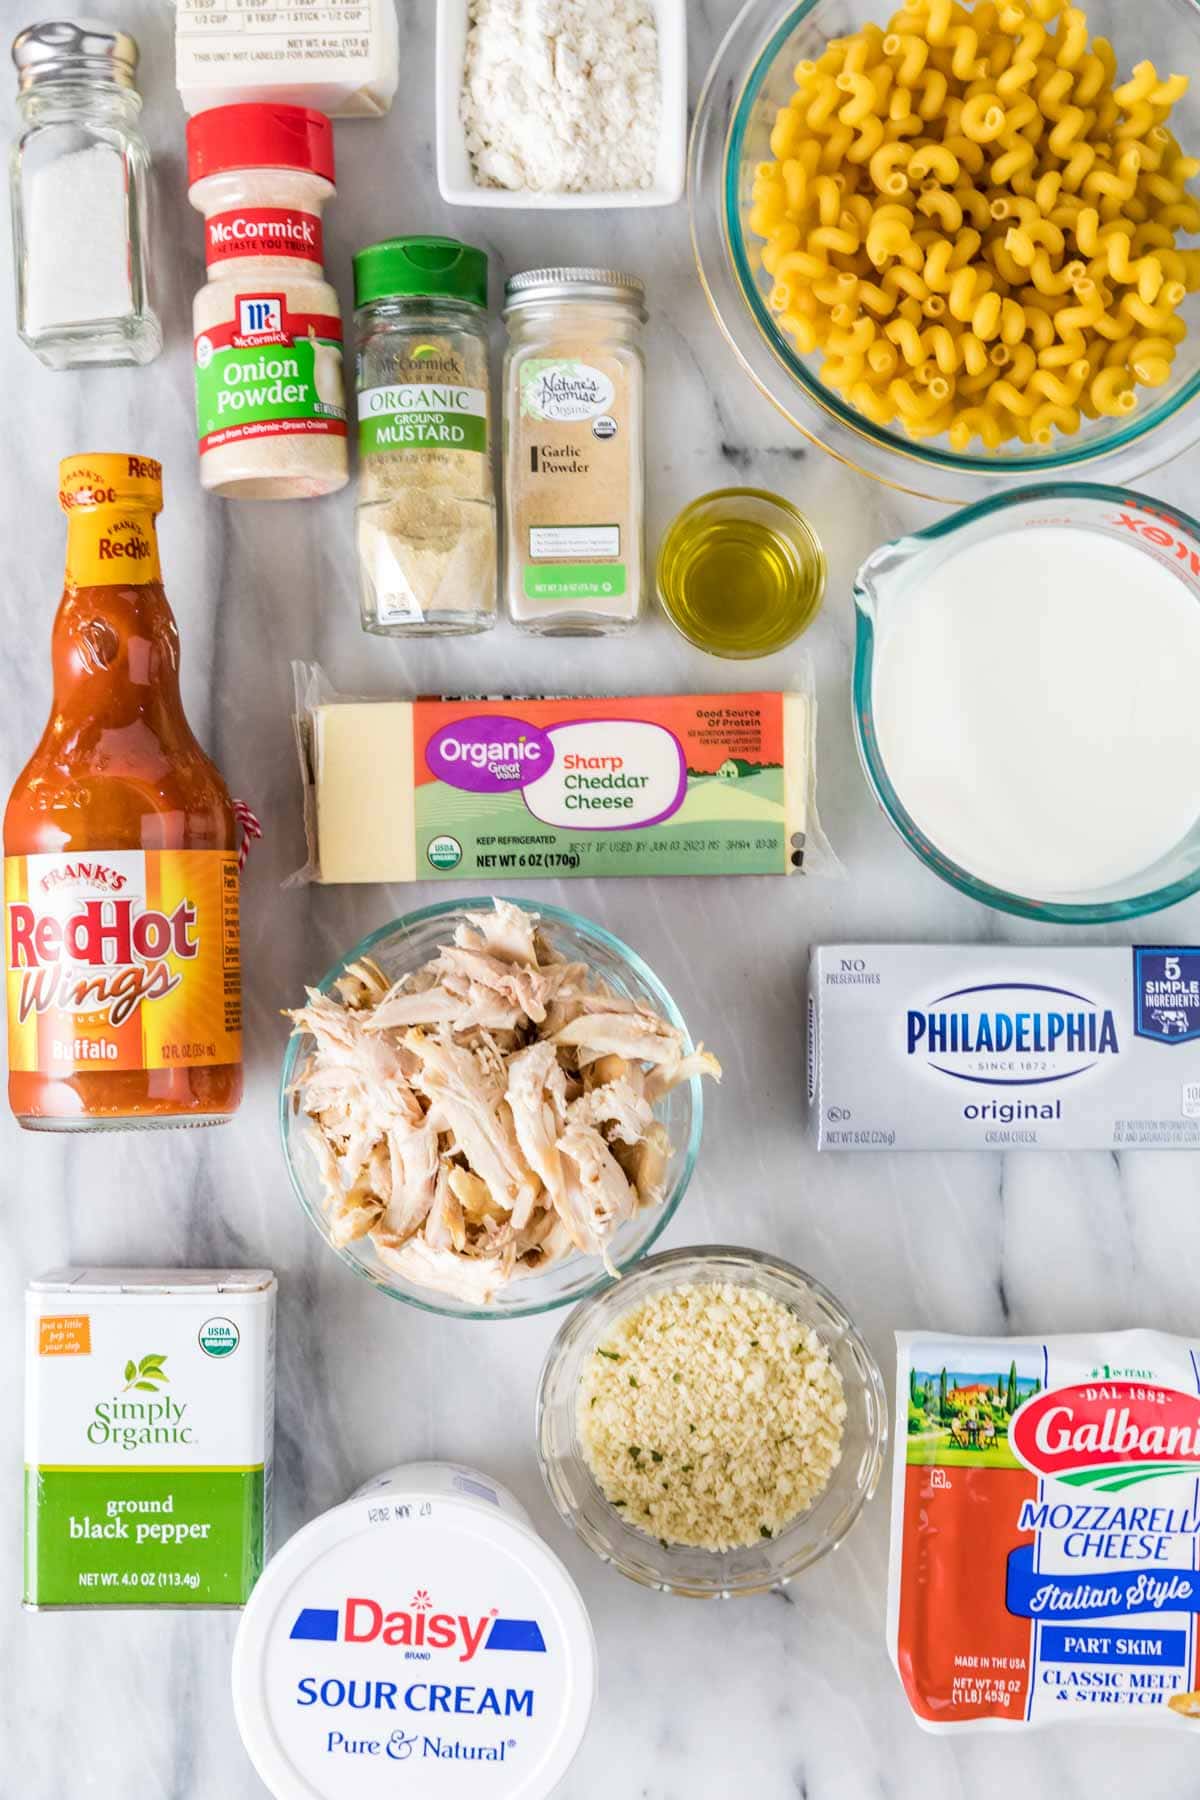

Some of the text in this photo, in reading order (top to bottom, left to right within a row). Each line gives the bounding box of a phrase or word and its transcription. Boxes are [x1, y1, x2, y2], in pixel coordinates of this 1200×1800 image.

[209, 14, 228, 24] CUP
[293, 12, 319, 21] STICK
[344, 11, 361, 20] CUP
[287, 40, 303, 48] NET
[210, 218, 314, 246] McCormick
[230, 240, 282, 250] TASTE YOU
[233, 332, 289, 348] McCormick
[223, 358, 299, 386] Onion
[541, 373, 599, 392] Nature's
[217, 382, 309, 415] Powder
[369, 388, 470, 411] ORGANIC
[540, 390, 607, 409] Promise
[549, 405, 590, 417] Organic
[394, 414, 445, 425] GROUND
[243, 422, 305, 435] California-Grown
[376, 425, 465, 445] MUSTARD
[541, 444, 581, 457] Garlic
[541, 460, 590, 473] Powder
[696, 709, 761, 718] Good Source
[707, 719, 761, 727] Of Protein
[439, 736, 541, 768] Organic
[487, 761, 520, 774] Great
[563, 754, 624, 773] Sharp
[495, 770, 521, 781] Value
[563, 773, 650, 790] Cheddar
[564, 794, 634, 810] Cheese
[434, 843, 455, 853] USDA
[476, 835, 557, 846] KEEP REFRIGERATED
[569, 842, 593, 853] BEST
[595, 841, 607, 852] IF
[609, 841, 633, 852] USED
[649, 841, 668, 852] JUN
[476, 853, 581, 870] NET WT 6 OZ (170g)
[40, 862, 128, 892] FRANK'S
[8, 899, 199, 968] RedHot
[840, 959, 866, 972] NO
[1165, 956, 1181, 980] 5
[826, 974, 881, 985] PRESERVATIVES
[1145, 981, 1200, 994] SIMPLE
[19, 962, 181, 1024] Wings
[1145, 994, 1200, 1008] INGREDIENTS
[907, 1010, 1120, 1054] PHILADELPHIA
[53, 1038, 119, 1060] Buffalo
[161, 1044, 170, 1060] 12
[977, 1062, 1048, 1071] SINCE 1872
[963, 1099, 1061, 1123] original
[826, 1130, 896, 1146] NET WT 8 OZ (226g)
[985, 1130, 1037, 1143] CREAM CHEESE
[207, 1327, 231, 1337] USDA
[1122, 1367, 1154, 1378] ITALY
[1086, 1387, 1166, 1405] DAL 1882
[95, 1396, 187, 1427] Simply
[87, 1420, 193, 1450] Organic
[1035, 1405, 1200, 1456] Galbani
[106, 1496, 174, 1517] ground
[69, 1517, 211, 1544] black pepper
[1064, 1532, 1173, 1561] CHEESE
[79, 1572, 201, 1588] NET WT. 4.0 OZ (113.4g)
[1029, 1573, 1193, 1612] Italian Style
[344, 1593, 489, 1663] Daisy
[1064, 1637, 1162, 1656] PART SKIM
[404, 1651, 431, 1661] BRAND
[954, 1655, 1026, 1670] MADE IN THE USA
[953, 1677, 973, 1689] NET
[975, 1678, 991, 1690] WT
[1007, 1680, 1021, 1693] OZ
[1042, 1669, 1181, 1690] CLASSIC MELT
[296, 1677, 534, 1718] SOUR CREAM
[952, 1688, 962, 1705] (1
[964, 1689, 982, 1705] LB)
[1056, 1689, 1164, 1705] & STRETCH
[327, 1729, 508, 1762] Pure & Natural
